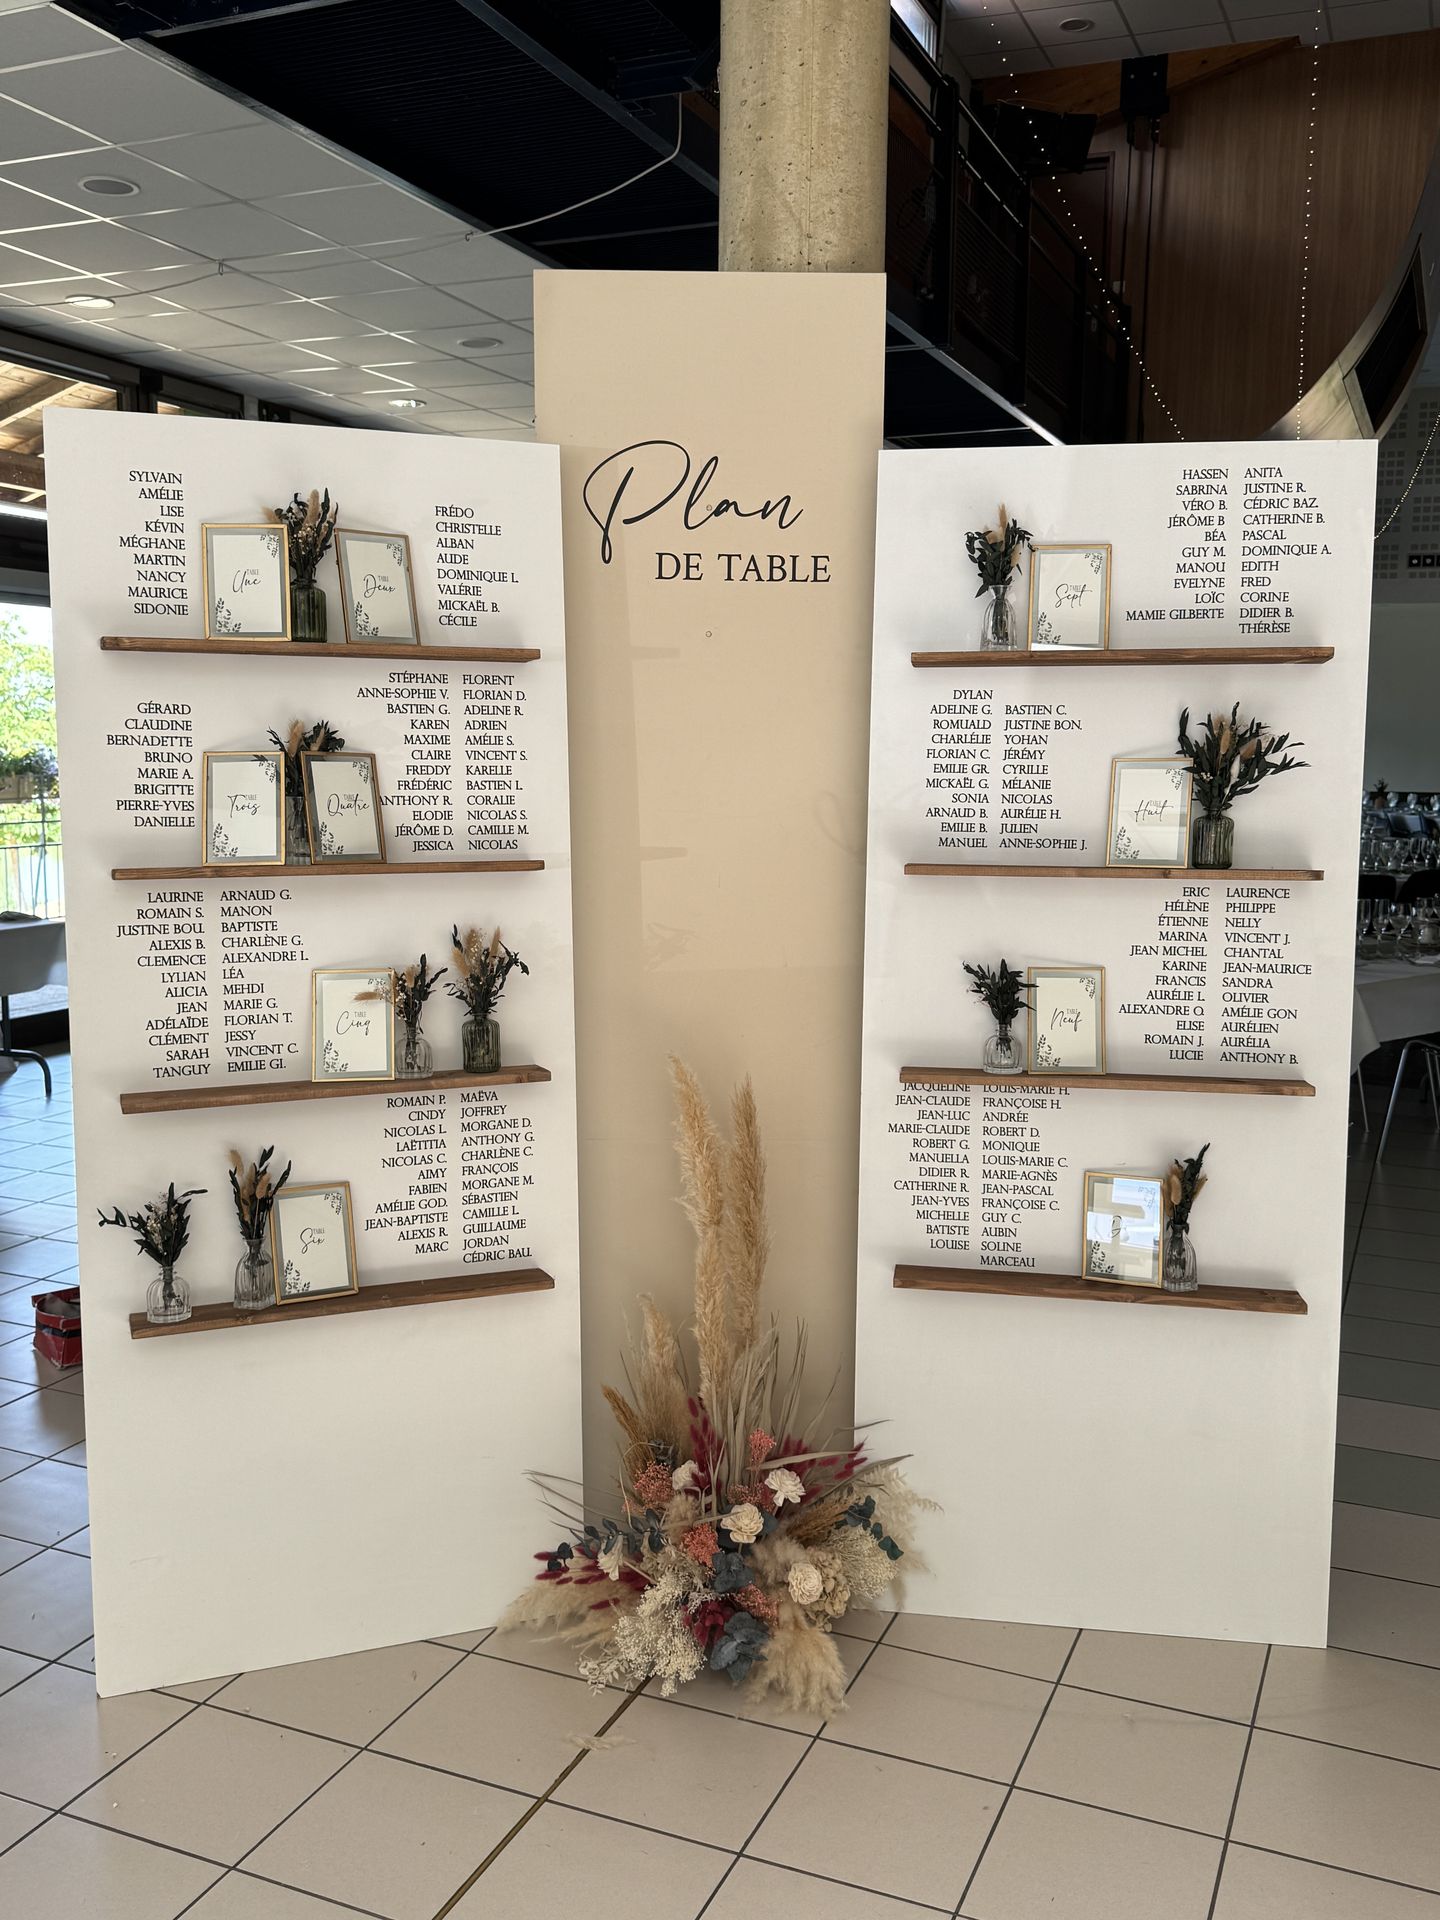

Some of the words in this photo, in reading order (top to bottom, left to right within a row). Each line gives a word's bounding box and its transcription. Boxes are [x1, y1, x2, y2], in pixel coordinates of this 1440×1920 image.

[129, 470, 182, 484] SYLVAIN
[1183, 469, 1228, 480] HASSEN
[1244, 467, 1283, 478] ANITA
[139, 486, 183, 501] AMÉLIE
[1176, 484, 1228, 495] SABRINA
[583, 440, 803, 564] Plan
[1244, 496, 1289, 509] CÉDRIC
[1293, 498, 1318, 508] BAZ.
[160, 505, 184, 517] LISE
[435, 504, 474, 518] FRÉDO
[145, 519, 184, 533] KÉVIN
[436, 521, 501, 536] CHRISTELLE
[1204, 528, 1226, 541] BÉA
[1242, 529, 1287, 541] PASCAL
[119, 534, 186, 550] MÉGHANE
[436, 537, 474, 549] ALBAN
[133, 553, 186, 567] MARTIN
[437, 553, 469, 565] AUDE
[655, 552, 703, 580] DE
[717, 553, 831, 582] TABLE
[1176, 562, 1225, 573] MANOU
[1241, 561, 1279, 572] EDITH
[137, 570, 186, 583] NANCY
[1241, 576, 1271, 587] FRED
[1174, 577, 1225, 589] EVELYNE
[128, 586, 188, 599] MAURICE
[438, 583, 482, 596] VALÉRIE
[1195, 591, 1224, 604] LOÏC
[1240, 592, 1289, 603] CORINE
[134, 603, 188, 615] SIDONIE
[1126, 610, 1165, 621] MAMIE
[1169, 608, 1224, 620] GILBERTE
[439, 613, 477, 627] CÉCILE
[1239, 620, 1290, 633] THÉRÈSE
[389, 670, 448, 684] STÉPHANE
[463, 674, 514, 685] FLORENT
[953, 690, 993, 700] DYLAN
[137, 700, 191, 715] GÉRARD
[125, 718, 192, 731] CLAUDINE
[410, 719, 449, 730] KAREN
[464, 720, 507, 730] ADRIEN
[933, 719, 991, 729] ROMUALD
[107, 735, 193, 747] BERNADETTE
[404, 734, 451, 745] MAXIME
[932, 732, 991, 744] CHARLÉLIE
[1004, 735, 1048, 745] YOHAN
[144, 752, 193, 763] BRUNO
[411, 750, 451, 760] CLAIRE
[1002, 747, 1045, 761] JÉRÉMY
[406, 765, 451, 775] FREDDY
[466, 765, 512, 775] KARELLE
[1003, 764, 1048, 775] CYRILLE
[397, 778, 452, 790] FRÉDÉRIC
[1002, 776, 1051, 789] MÉLANIE
[134, 784, 194, 795] BRIGITTE
[467, 795, 515, 805] CORALIE
[952, 793, 989, 803] SONIA
[1001, 794, 1052, 804] NICOLAS
[116, 800, 194, 811] PIERRE-YVES
[134, 816, 195, 827] DANIELLE
[412, 810, 453, 821] ELODIE
[999, 823, 1038, 834] JULIEN
[412, 841, 454, 852] JESSICA
[468, 839, 518, 850] NICOLAS
[938, 837, 987, 848] MANUEL
[147, 891, 204, 903] LAURINE
[1183, 887, 1210, 897] ERIC
[1226, 888, 1290, 898] LAURENCE
[221, 905, 272, 917] MANON
[1165, 899, 1209, 912] HÉLÈNE
[1226, 903, 1275, 913] PHILIPPE
[1158, 913, 1208, 927] ÉTIENNE
[1225, 917, 1262, 928] NELLY
[116, 924, 170, 937] JUSTINE
[172, 923, 205, 935] BOU.
[221, 921, 278, 932] BAPTISTE
[1158, 931, 1207, 942] MARINA
[1129, 945, 1159, 956] JEAN
[1162, 946, 1207, 957] MICHEL
[1224, 947, 1284, 959] CHANTAL
[137, 954, 206, 967] CLEMENCE
[1162, 961, 1206, 971] KARINE
[223, 966, 244, 979] LÉA
[1222, 962, 1312, 974] JEAN-MAURICE
[161, 971, 206, 983] LYLIAN
[1155, 975, 1206, 986] FRANCIS
[1222, 977, 1273, 988] SANDRA
[165, 986, 208, 998] ALICIA
[223, 983, 264, 995] MEHDI
[1222, 992, 1269, 1003] OLIVIER
[176, 1001, 207, 1014] JEAN
[1221, 1005, 1263, 1018] AMÉLIE
[1267, 1008, 1298, 1019] GON
[145, 1016, 209, 1031] ADÉLAÏDE
[1176, 1020, 1204, 1031] ELISE
[1221, 1018, 1279, 1033] AURÉLIEN
[148, 1031, 209, 1047] CLÉMENT
[225, 1030, 256, 1043] JESSY
[1220, 1035, 1271, 1048] AURÉLIA
[166, 1048, 209, 1061] SARAH
[1169, 1050, 1203, 1060] LUCIE
[153, 1064, 211, 1078] TANGUY
[461, 1090, 498, 1103] MAËVA
[895, 1095, 970, 1106] JEAN-CLAUDE
[408, 1109, 446, 1121] CINDY
[460, 1105, 507, 1119] JOFFREY
[917, 1110, 970, 1121] JEAN-LUC
[982, 1108, 1028, 1122] ANDRÉE
[888, 1123, 970, 1135] MARIE-CLAUDE
[396, 1138, 447, 1153] LAËTITIA
[982, 1140, 1040, 1152] MONIQUE
[909, 1152, 969, 1164] MANUELLA
[418, 1168, 447, 1180] AIMY
[462, 1162, 518, 1176] FRANÇOIS
[982, 1166, 1057, 1181] MARIE-AGNÈS
[409, 1183, 447, 1195] FABIEN
[981, 1184, 1054, 1196] JEAN-PASCAL
[461, 1190, 519, 1206] SÉBASTIEN
[911, 1195, 969, 1207] JEAN-YVES
[375, 1199, 415, 1214] AMÉLIE
[418, 1198, 448, 1209] GOD.
[916, 1209, 969, 1221] MICHELLE
[365, 1212, 449, 1232] JEAN-BAPTISTE
[462, 1219, 527, 1235] GUILLAUME
[926, 1224, 969, 1235] BATISTE
[981, 1227, 1017, 1237] AUBIN
[415, 1241, 448, 1254] MARC
[462, 1234, 510, 1251] JORDAN
[930, 1239, 969, 1250] LOUISE
[981, 1241, 1021, 1252] SOLINE
[462, 1249, 506, 1264] CÉDRIC
[508, 1247, 532, 1258] BAU.
[980, 1255, 1035, 1267] MARCEAU
